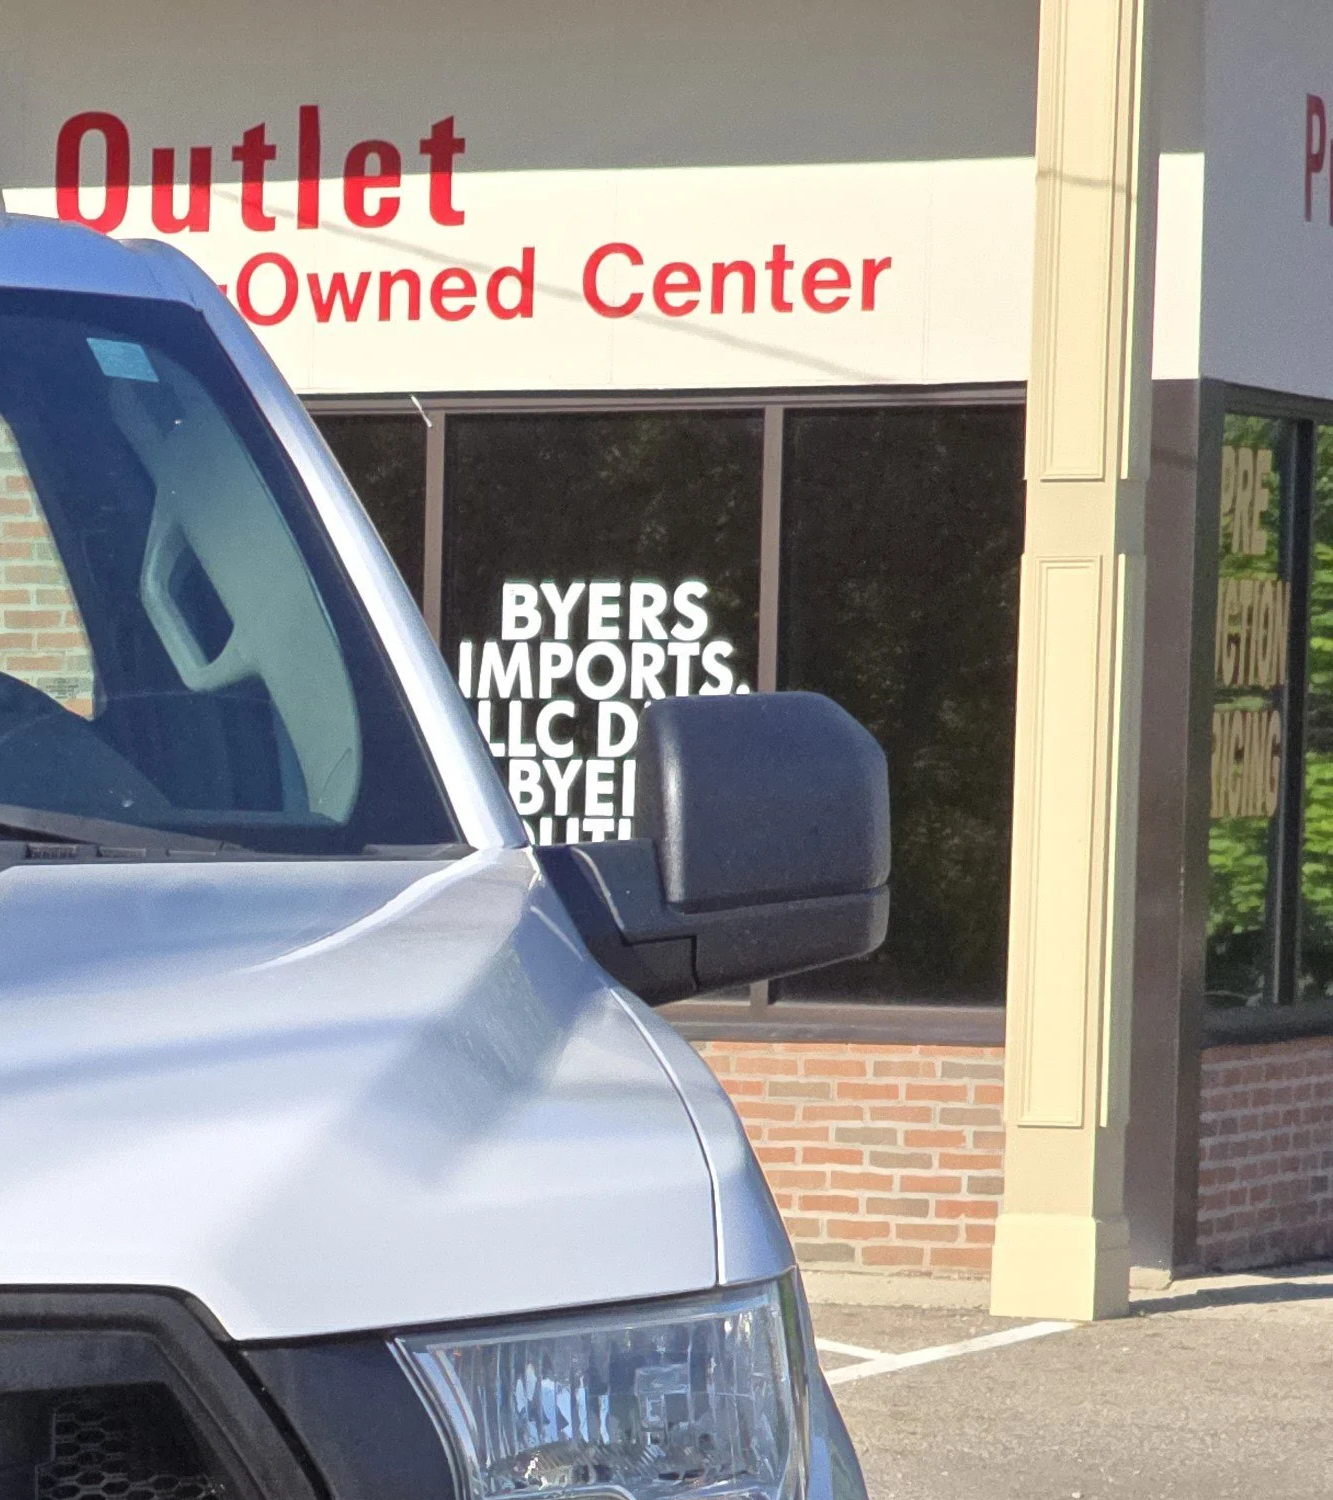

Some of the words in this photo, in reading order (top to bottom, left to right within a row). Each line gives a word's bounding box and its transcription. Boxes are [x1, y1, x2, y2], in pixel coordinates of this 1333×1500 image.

[55, 105, 466, 235] Outlet
[1305, 93, 1333, 227] P
[217, 246, 536, 326] Owned
[583, 242, 892, 318] Center
[501, 581, 709, 641] BYERS
[478, 700, 575, 758] LLC
